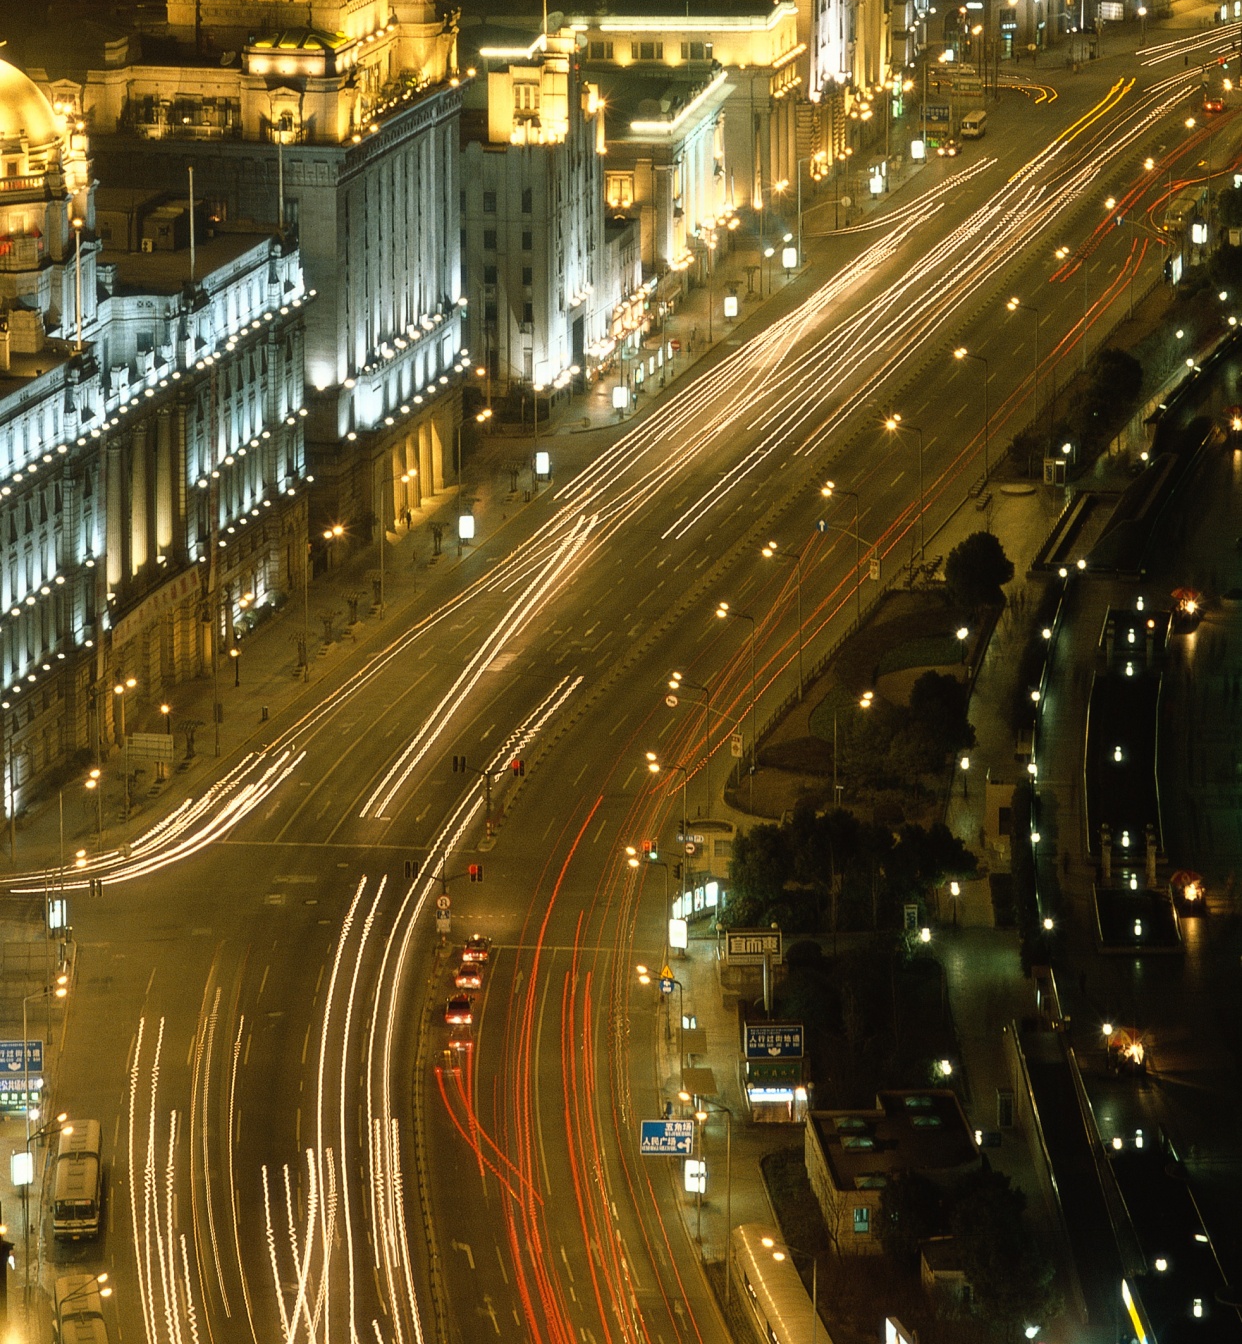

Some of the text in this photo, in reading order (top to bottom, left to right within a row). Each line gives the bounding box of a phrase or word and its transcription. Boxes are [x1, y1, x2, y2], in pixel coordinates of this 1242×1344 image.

[665, 1122, 692, 1131] 五角场
[642, 1136, 676, 1146] 人民广场
